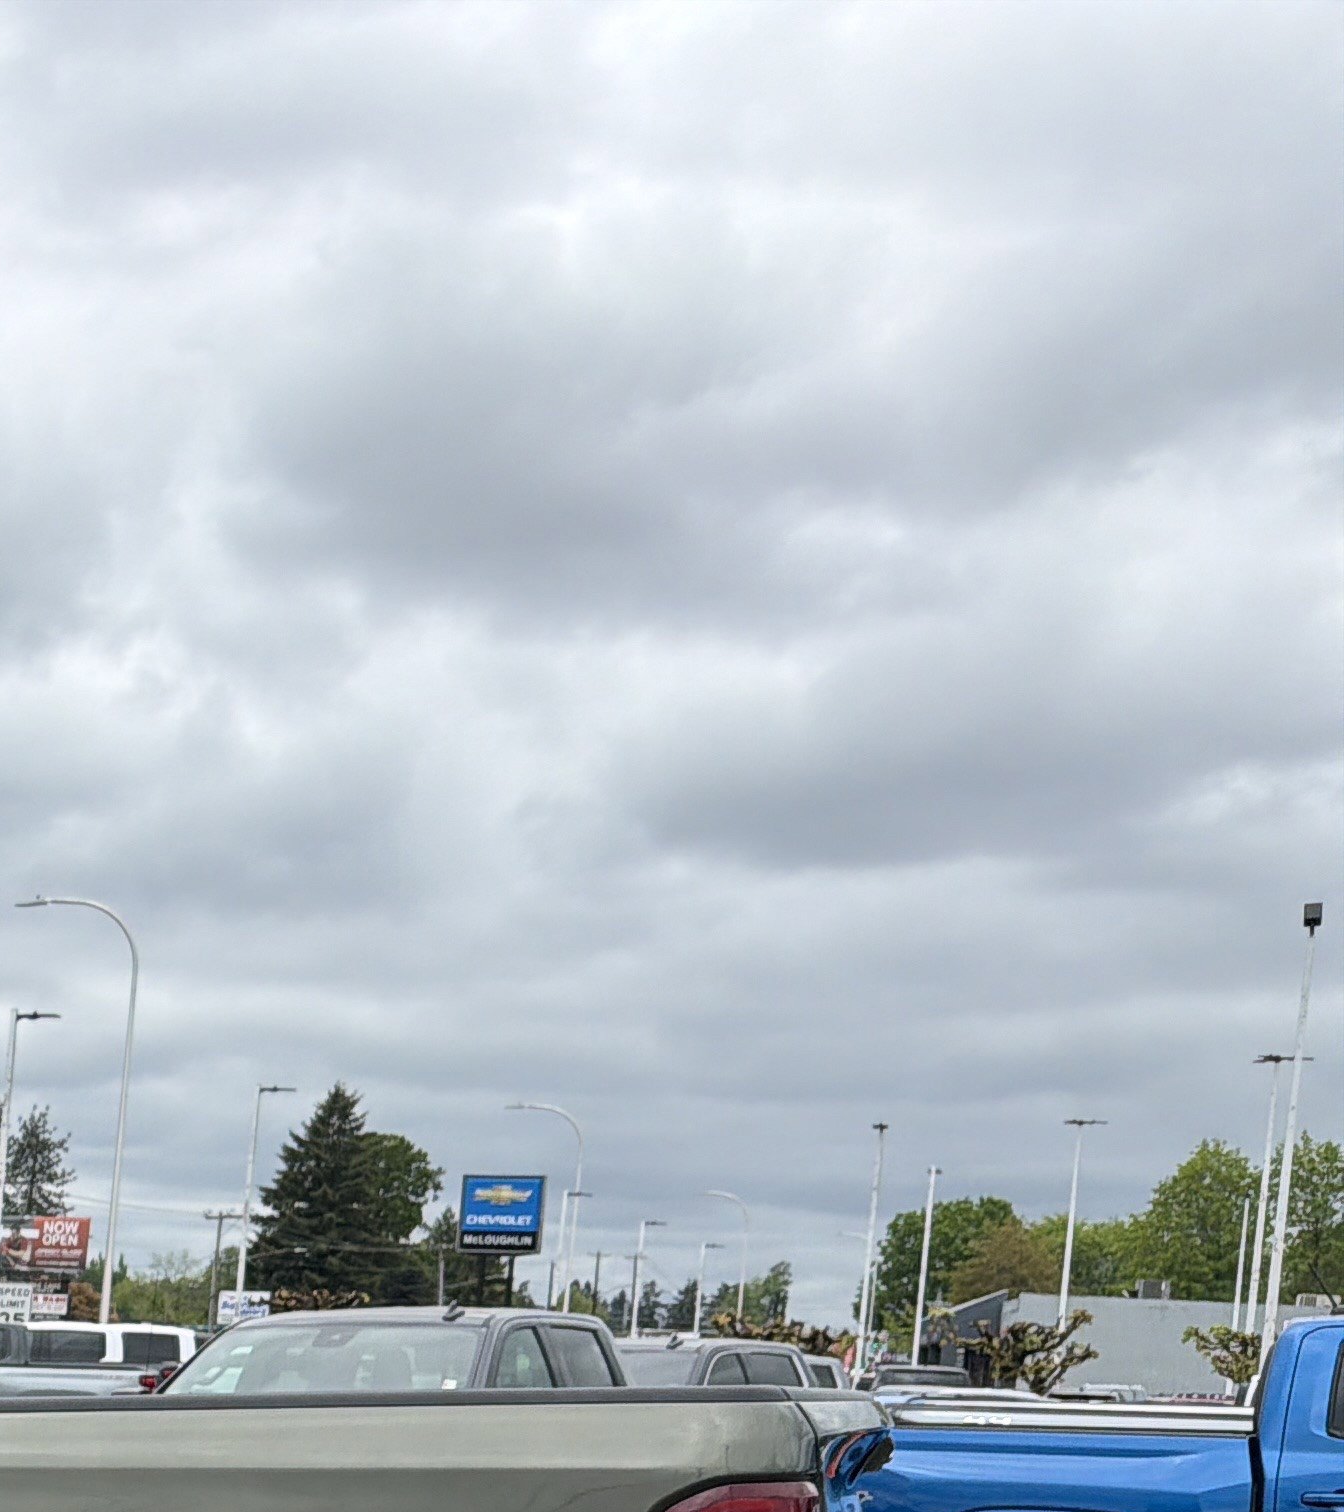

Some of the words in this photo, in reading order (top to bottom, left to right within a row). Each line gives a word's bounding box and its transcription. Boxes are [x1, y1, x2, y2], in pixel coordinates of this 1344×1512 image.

[465, 1214, 533, 1226] CHEVROLET
[43, 1221, 80, 1234] NOW
[42, 1234, 78, 1246] OPEN
[463, 1234, 532, 1245] McLOUGHLIN
